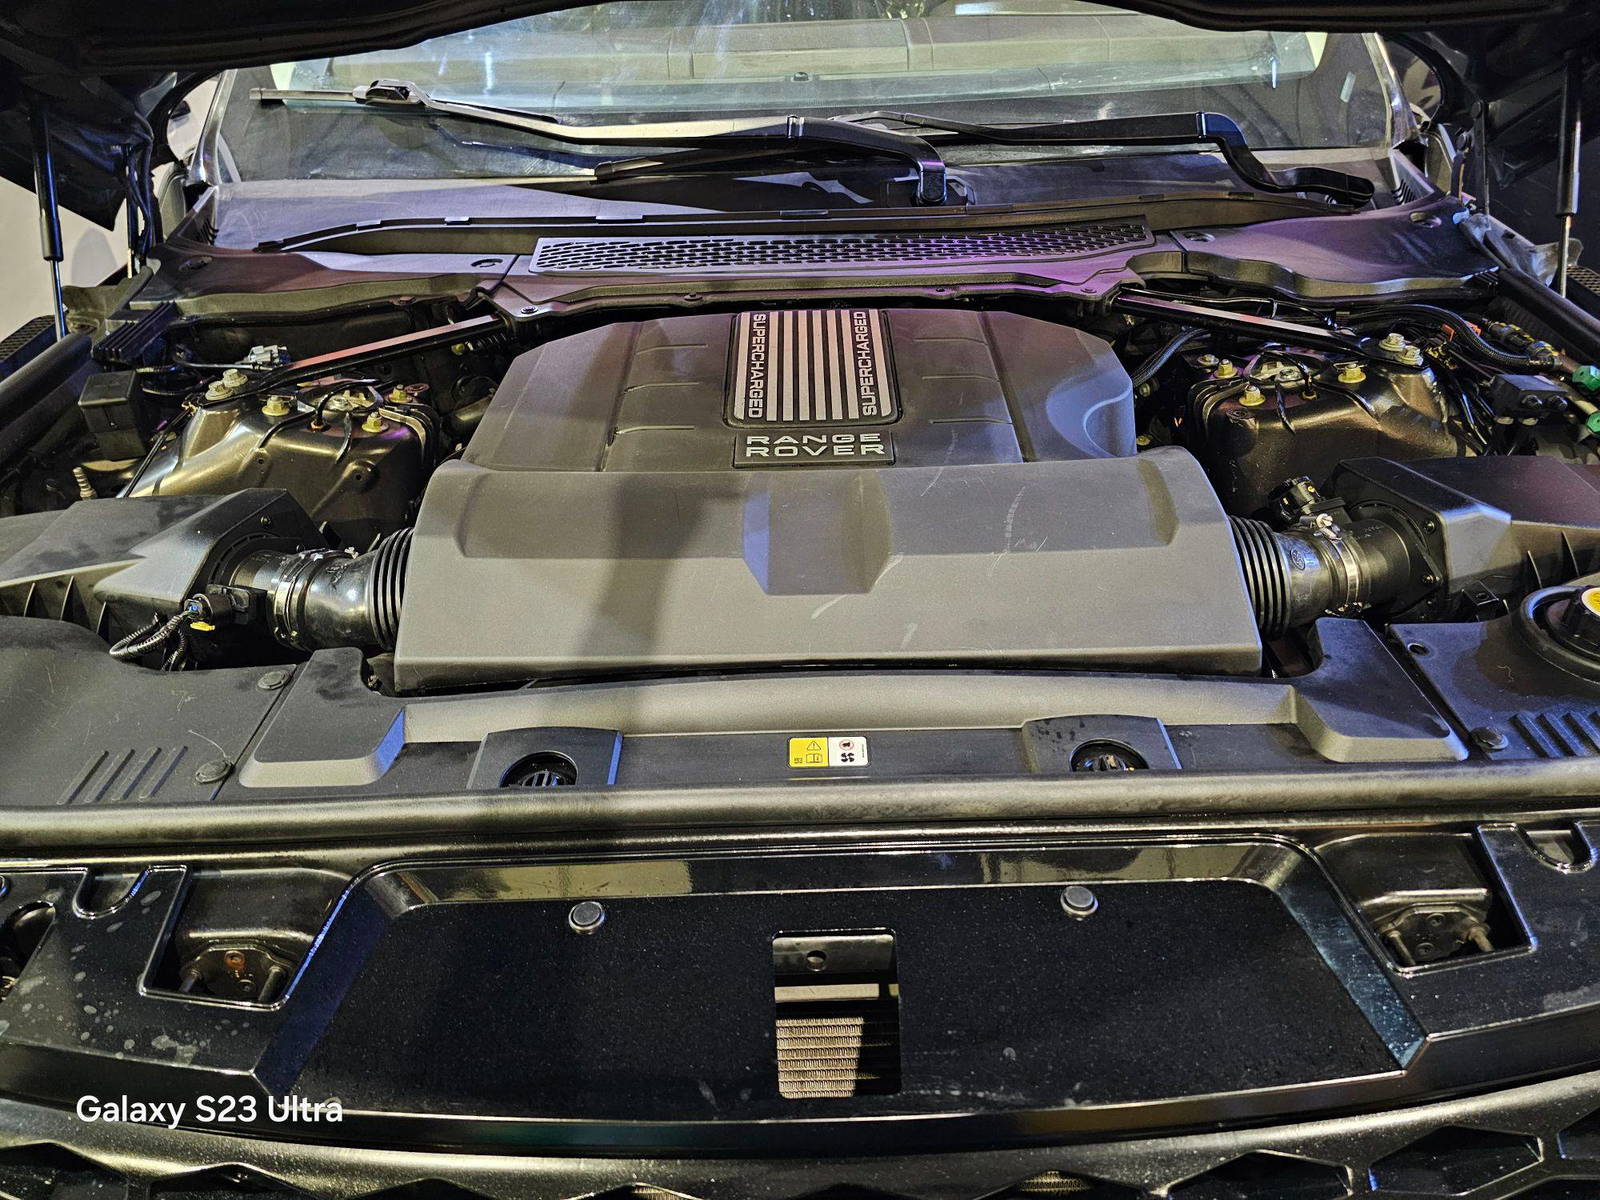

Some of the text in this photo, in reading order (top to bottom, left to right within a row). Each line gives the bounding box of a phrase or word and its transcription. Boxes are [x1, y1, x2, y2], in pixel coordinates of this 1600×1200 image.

[748, 313, 766, 418] SUPERCHARGED
[853, 311, 877, 416] SUPERCHARGED
[745, 444, 885, 457] ROVER
[746, 433, 881, 445] RANGE
